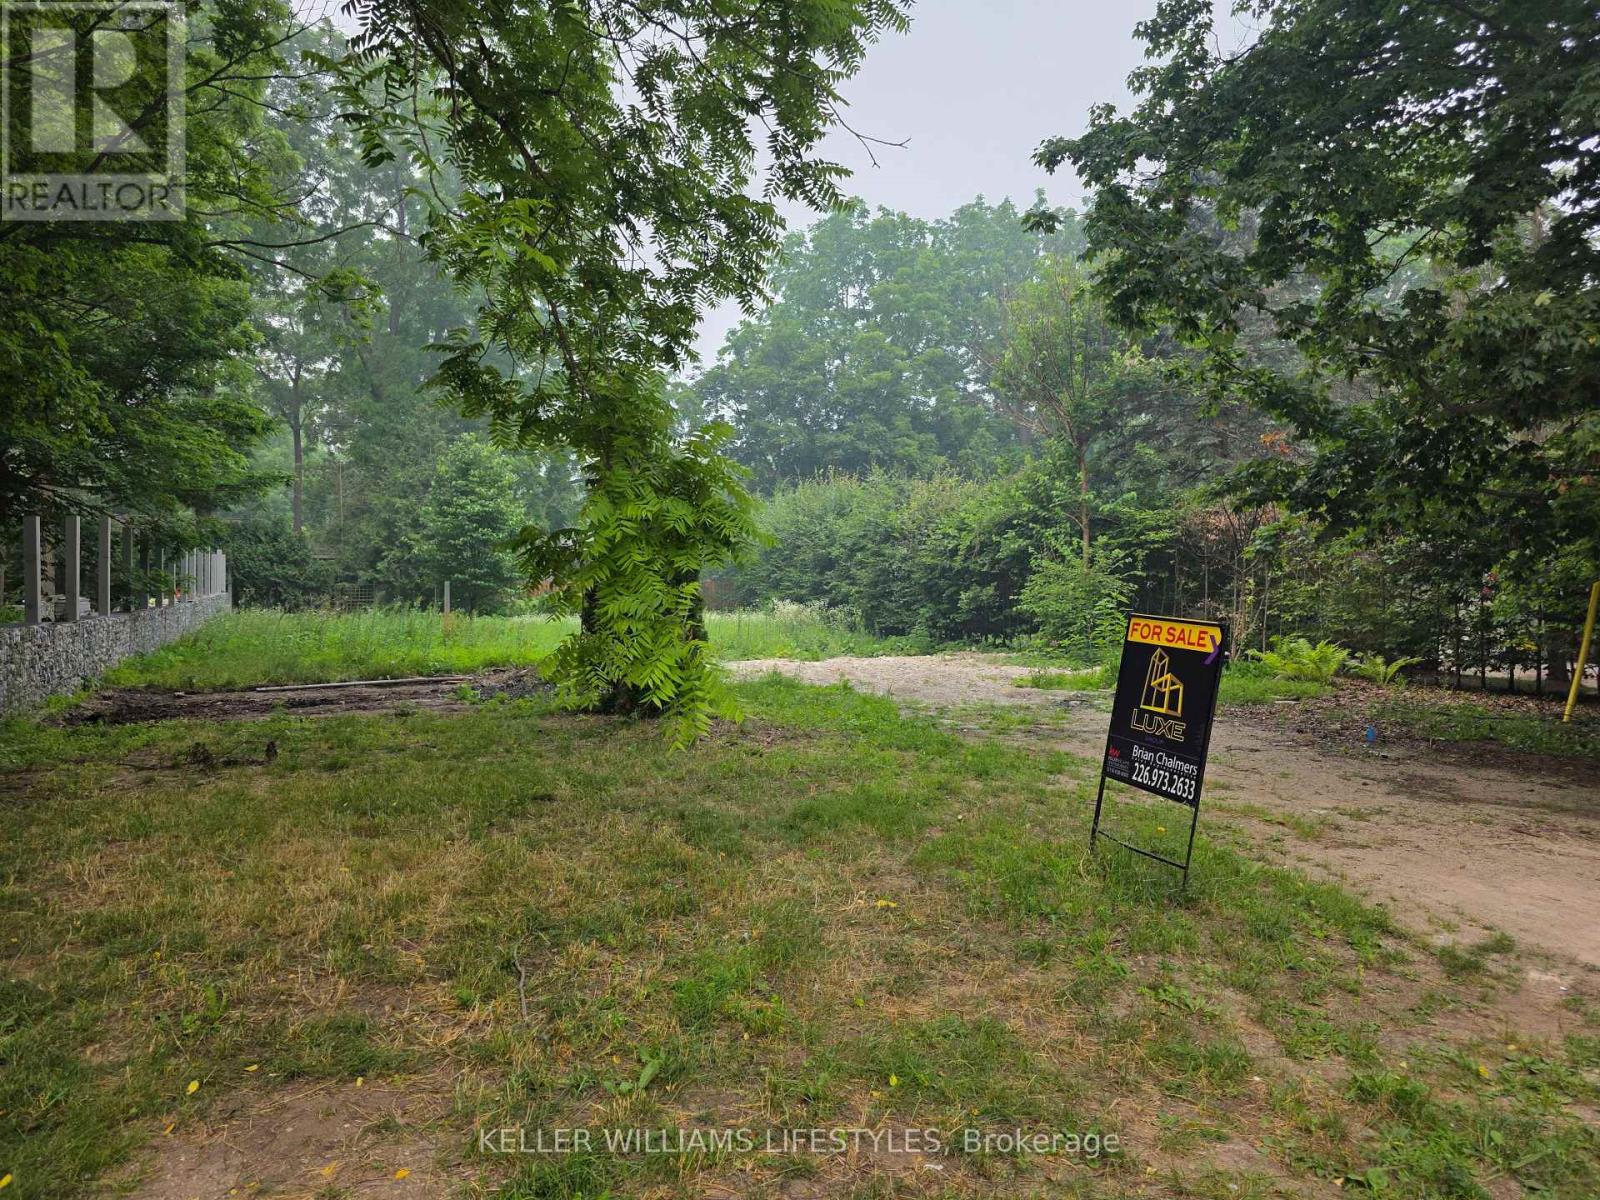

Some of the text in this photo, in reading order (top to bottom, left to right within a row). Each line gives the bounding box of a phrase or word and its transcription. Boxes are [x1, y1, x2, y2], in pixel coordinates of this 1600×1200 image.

[1130, 622, 1208, 647] FOR SALE
[1131, 708, 1186, 741] LUXE
[1132, 745, 1154, 762] Brian
[1155, 752, 1198, 775] Chalmers
[1131, 763, 1196, 799] 226.973.2633
